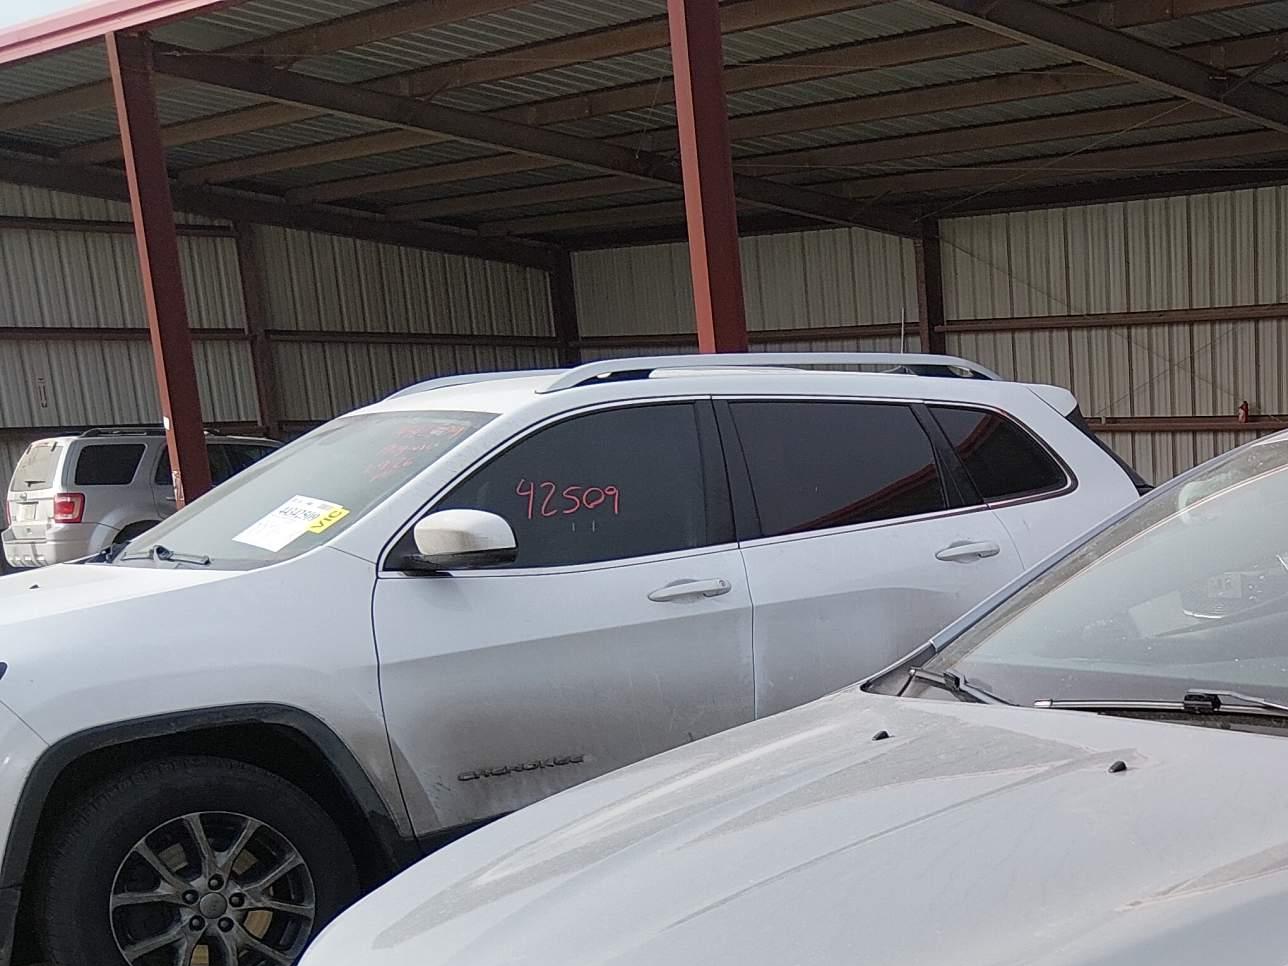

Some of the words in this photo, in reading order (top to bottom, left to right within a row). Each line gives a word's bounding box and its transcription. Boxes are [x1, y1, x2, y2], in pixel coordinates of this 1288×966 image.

[515, 478, 621, 521] 42509
[310, 509, 343, 530] VIC
[457, 754, 584, 781] CHEROKEE
